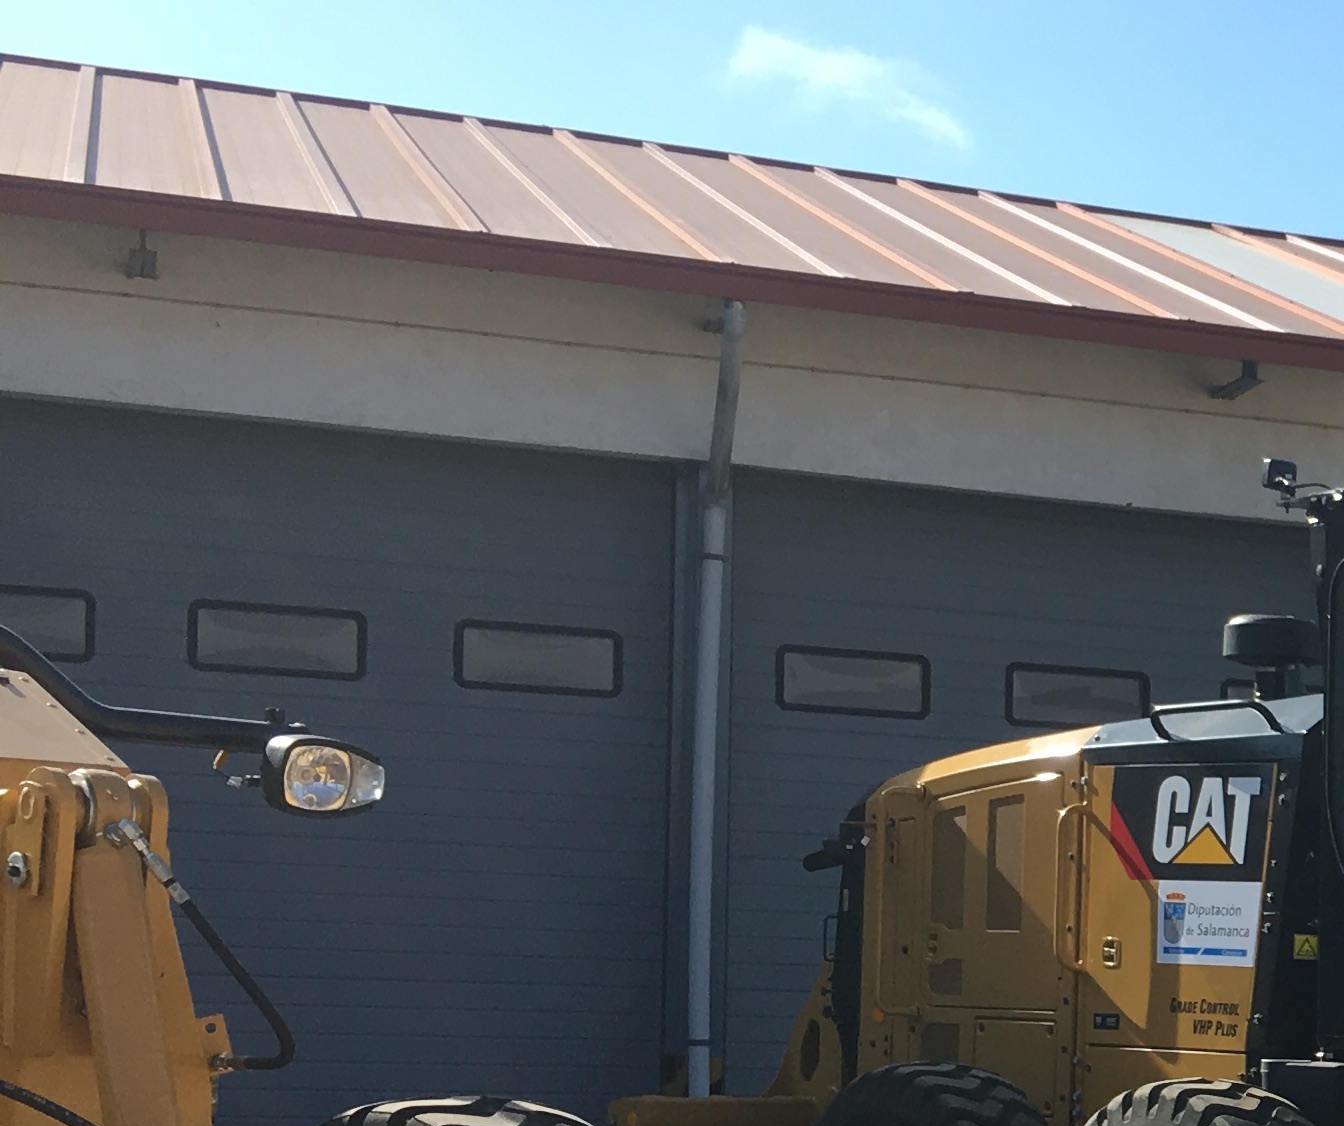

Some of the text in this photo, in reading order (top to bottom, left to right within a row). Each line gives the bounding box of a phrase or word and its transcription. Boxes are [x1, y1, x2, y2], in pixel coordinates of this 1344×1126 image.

[1152, 775, 1262, 865] CAT
[1187, 902, 1242, 918] Diputación
[1185, 923, 1251, 938] de Salamanca
[1192, 1019, 1214, 1036] VHP
